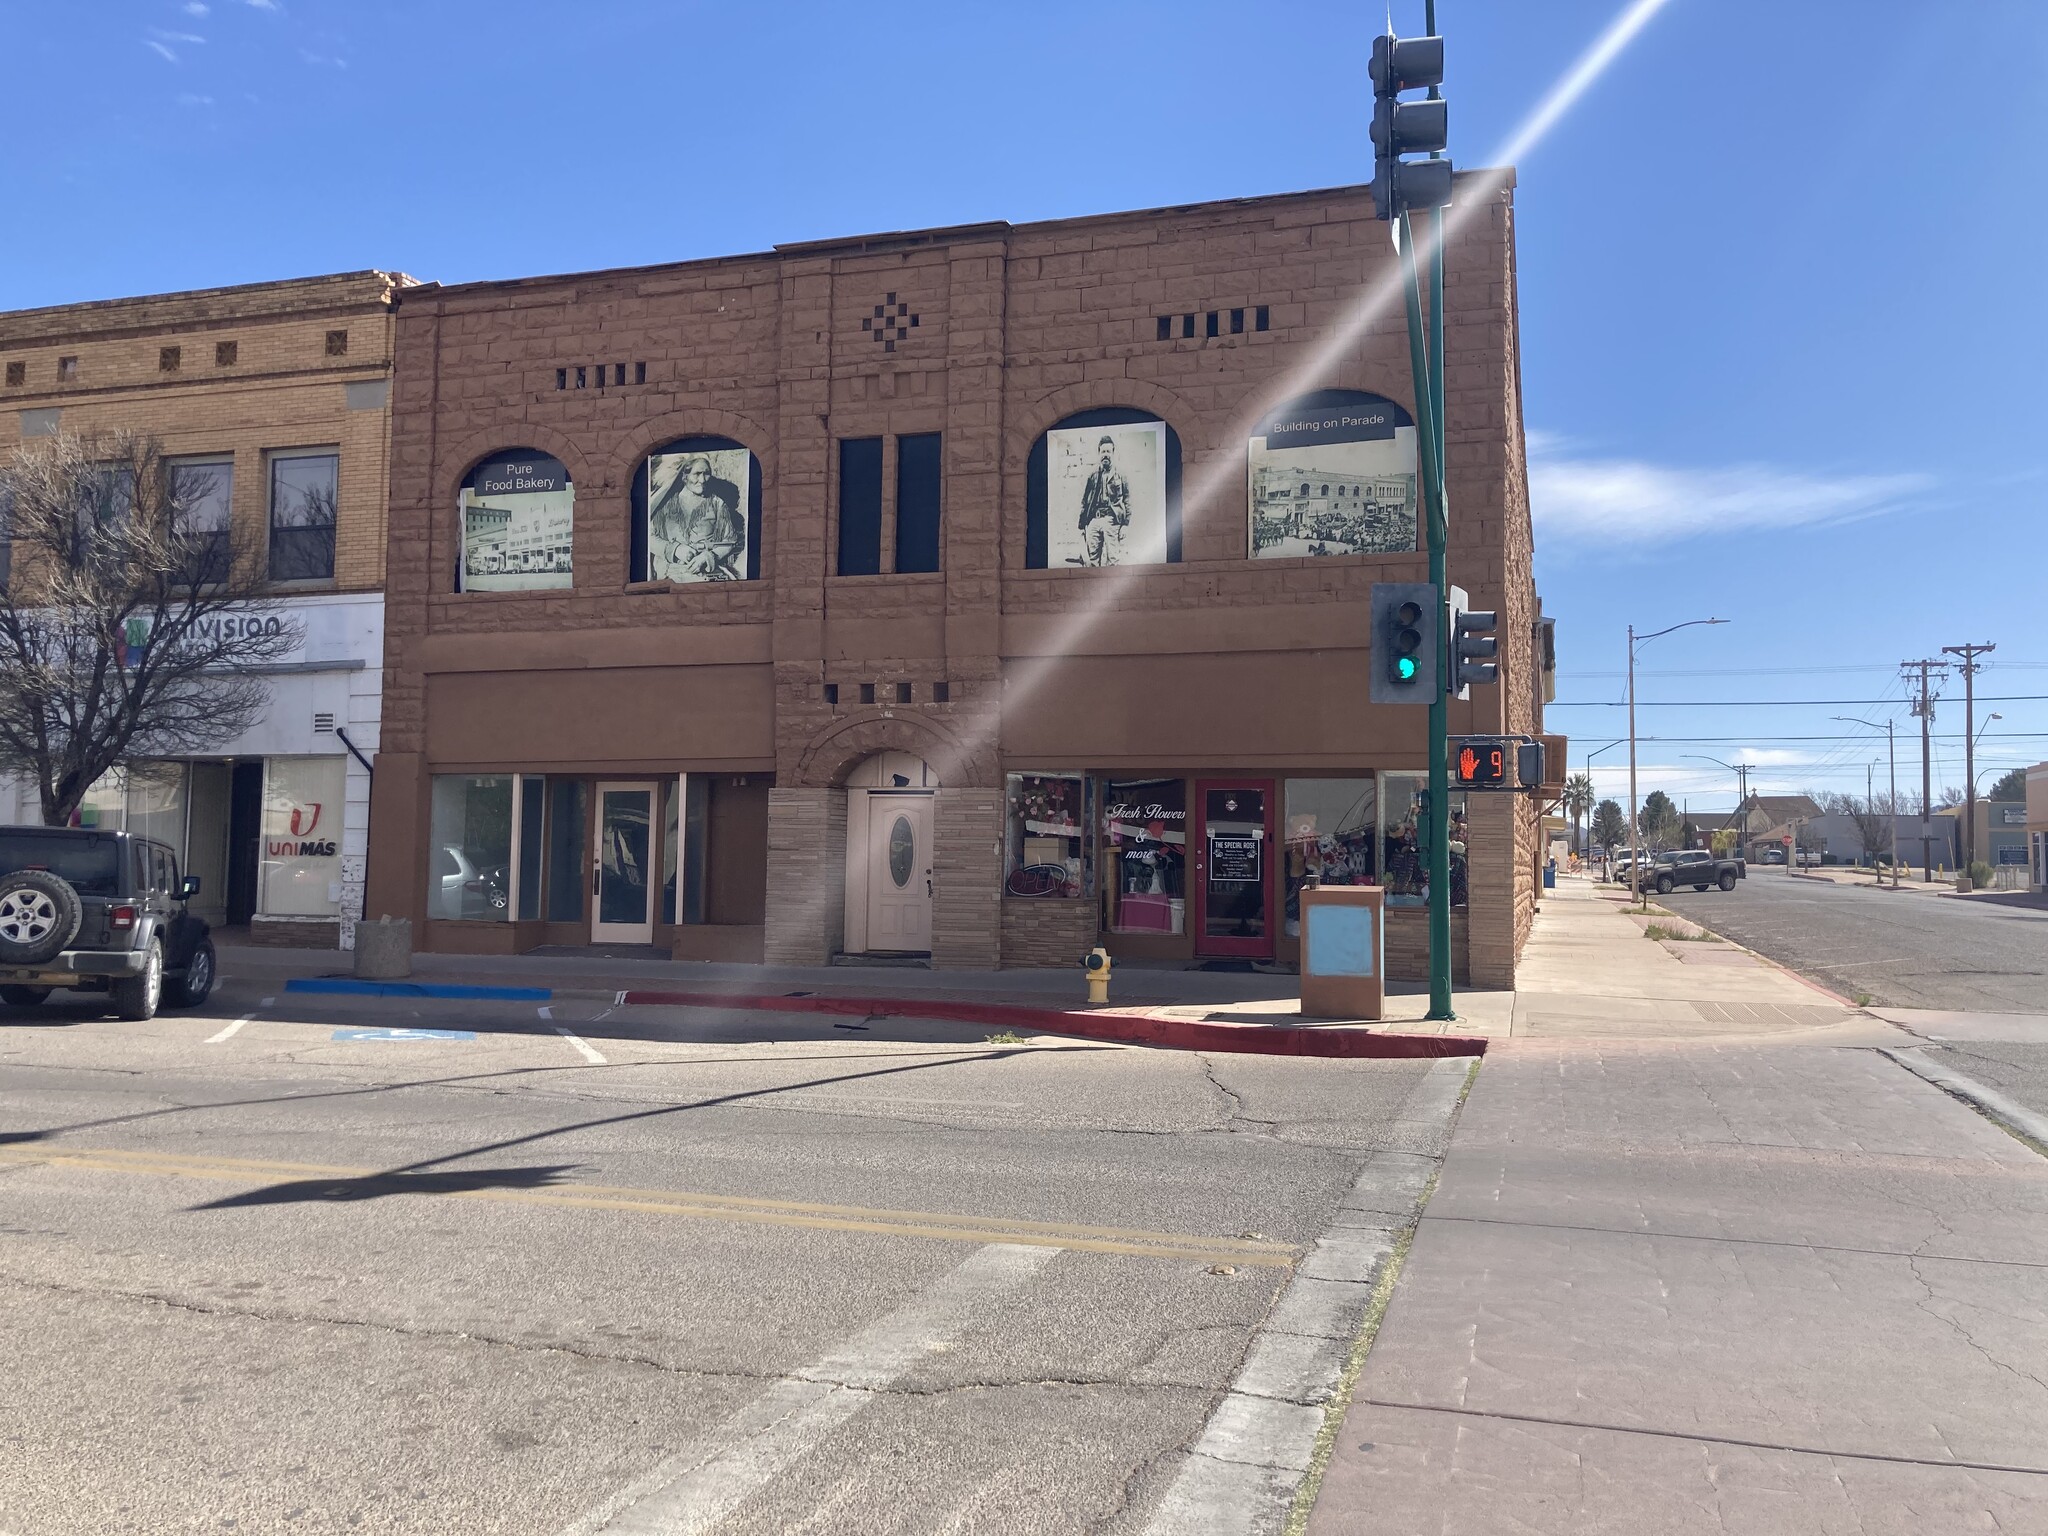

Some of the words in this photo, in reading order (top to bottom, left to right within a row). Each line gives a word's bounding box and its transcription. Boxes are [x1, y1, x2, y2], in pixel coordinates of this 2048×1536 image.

[1274, 420, 1320, 433] Building
[1323, 419, 1338, 429] on
[1342, 414, 1385, 427] Parade
[506, 464, 533, 475] Pure
[485, 479, 513, 491] Food
[516, 477, 555, 490] Bakery
[1491, 751, 1502, 777] 9
[1110, 803, 1141, 819] Fresh
[1143, 803, 1186, 819] Flowers
[1135, 827, 1147, 843] &
[1215, 841, 1223, 849] THE
[1224, 841, 1242, 849] SPECIAL
[1243, 841, 1256, 849] ROSE
[1125, 850, 1153, 859] more
[1010, 869, 1060, 891] OPEN
